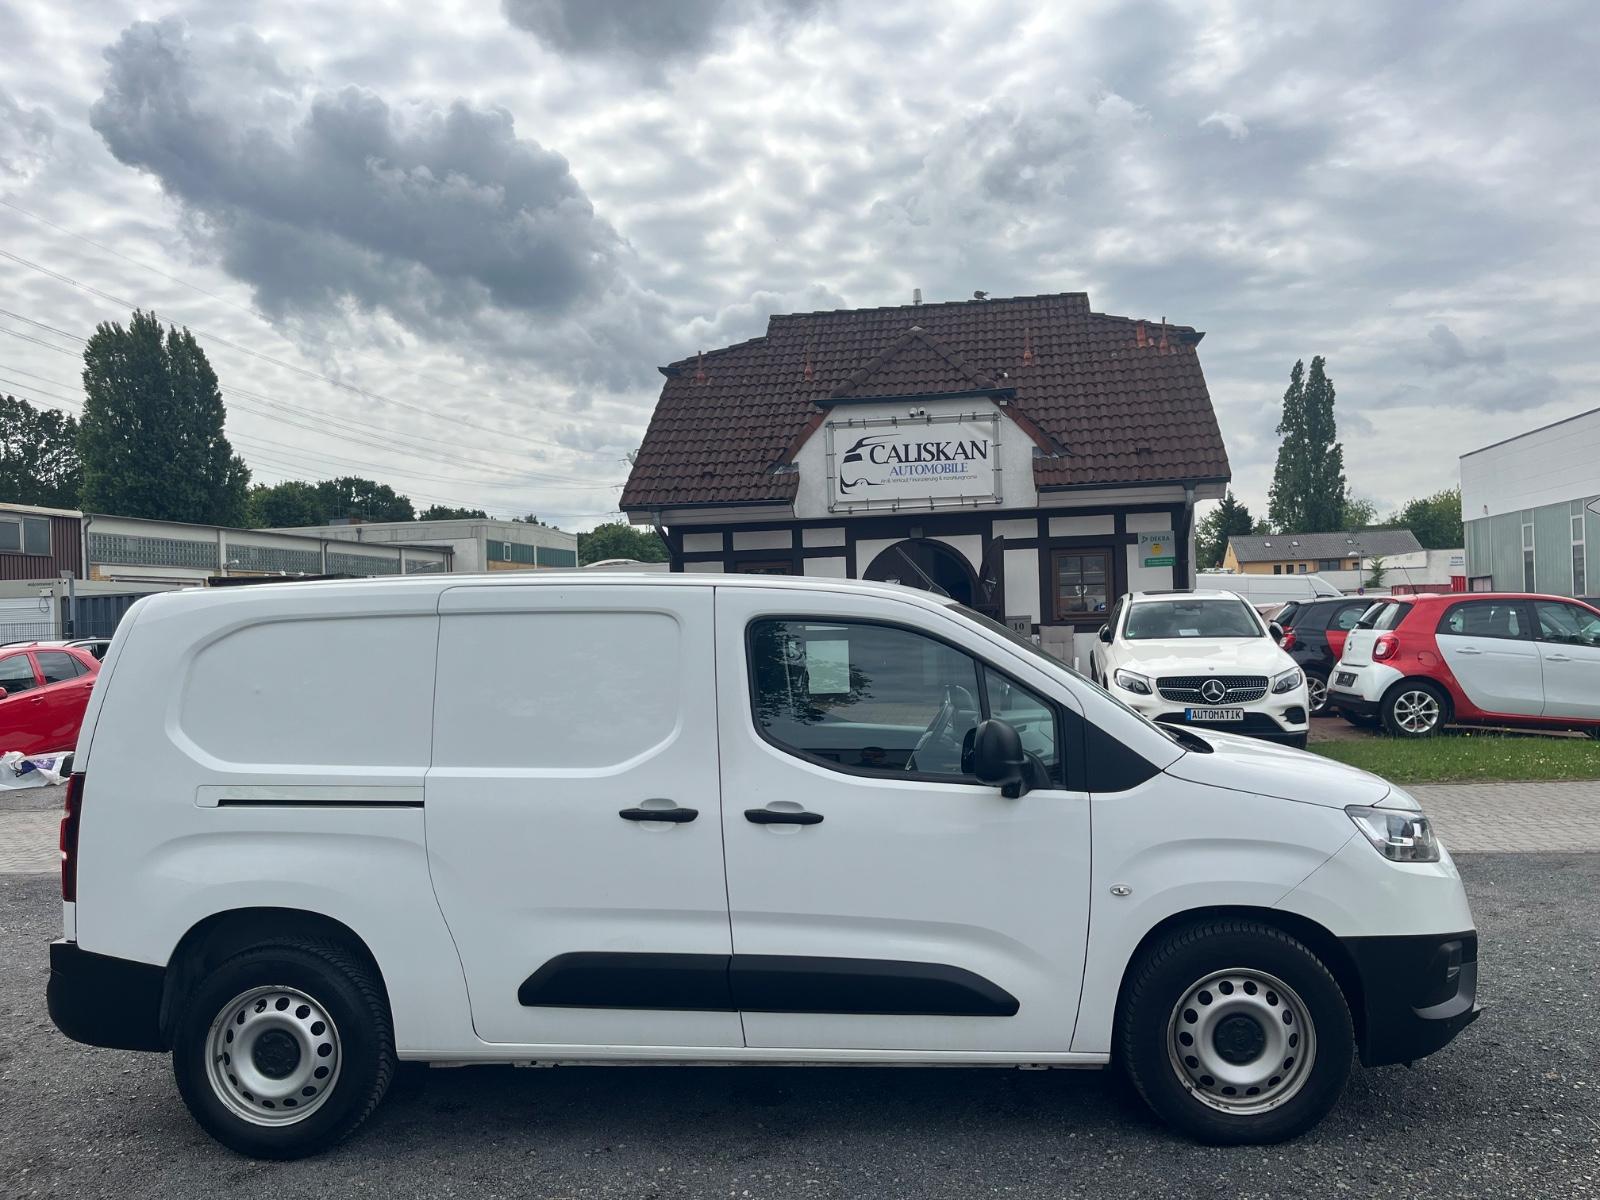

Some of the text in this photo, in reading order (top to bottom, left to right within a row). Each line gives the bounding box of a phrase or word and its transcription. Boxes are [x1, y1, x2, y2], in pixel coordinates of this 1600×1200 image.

[869, 440, 988, 464] CALISKAN
[889, 463, 968, 477] AUTOMOBILE
[1192, 710, 1241, 720] AUTOMATIK
